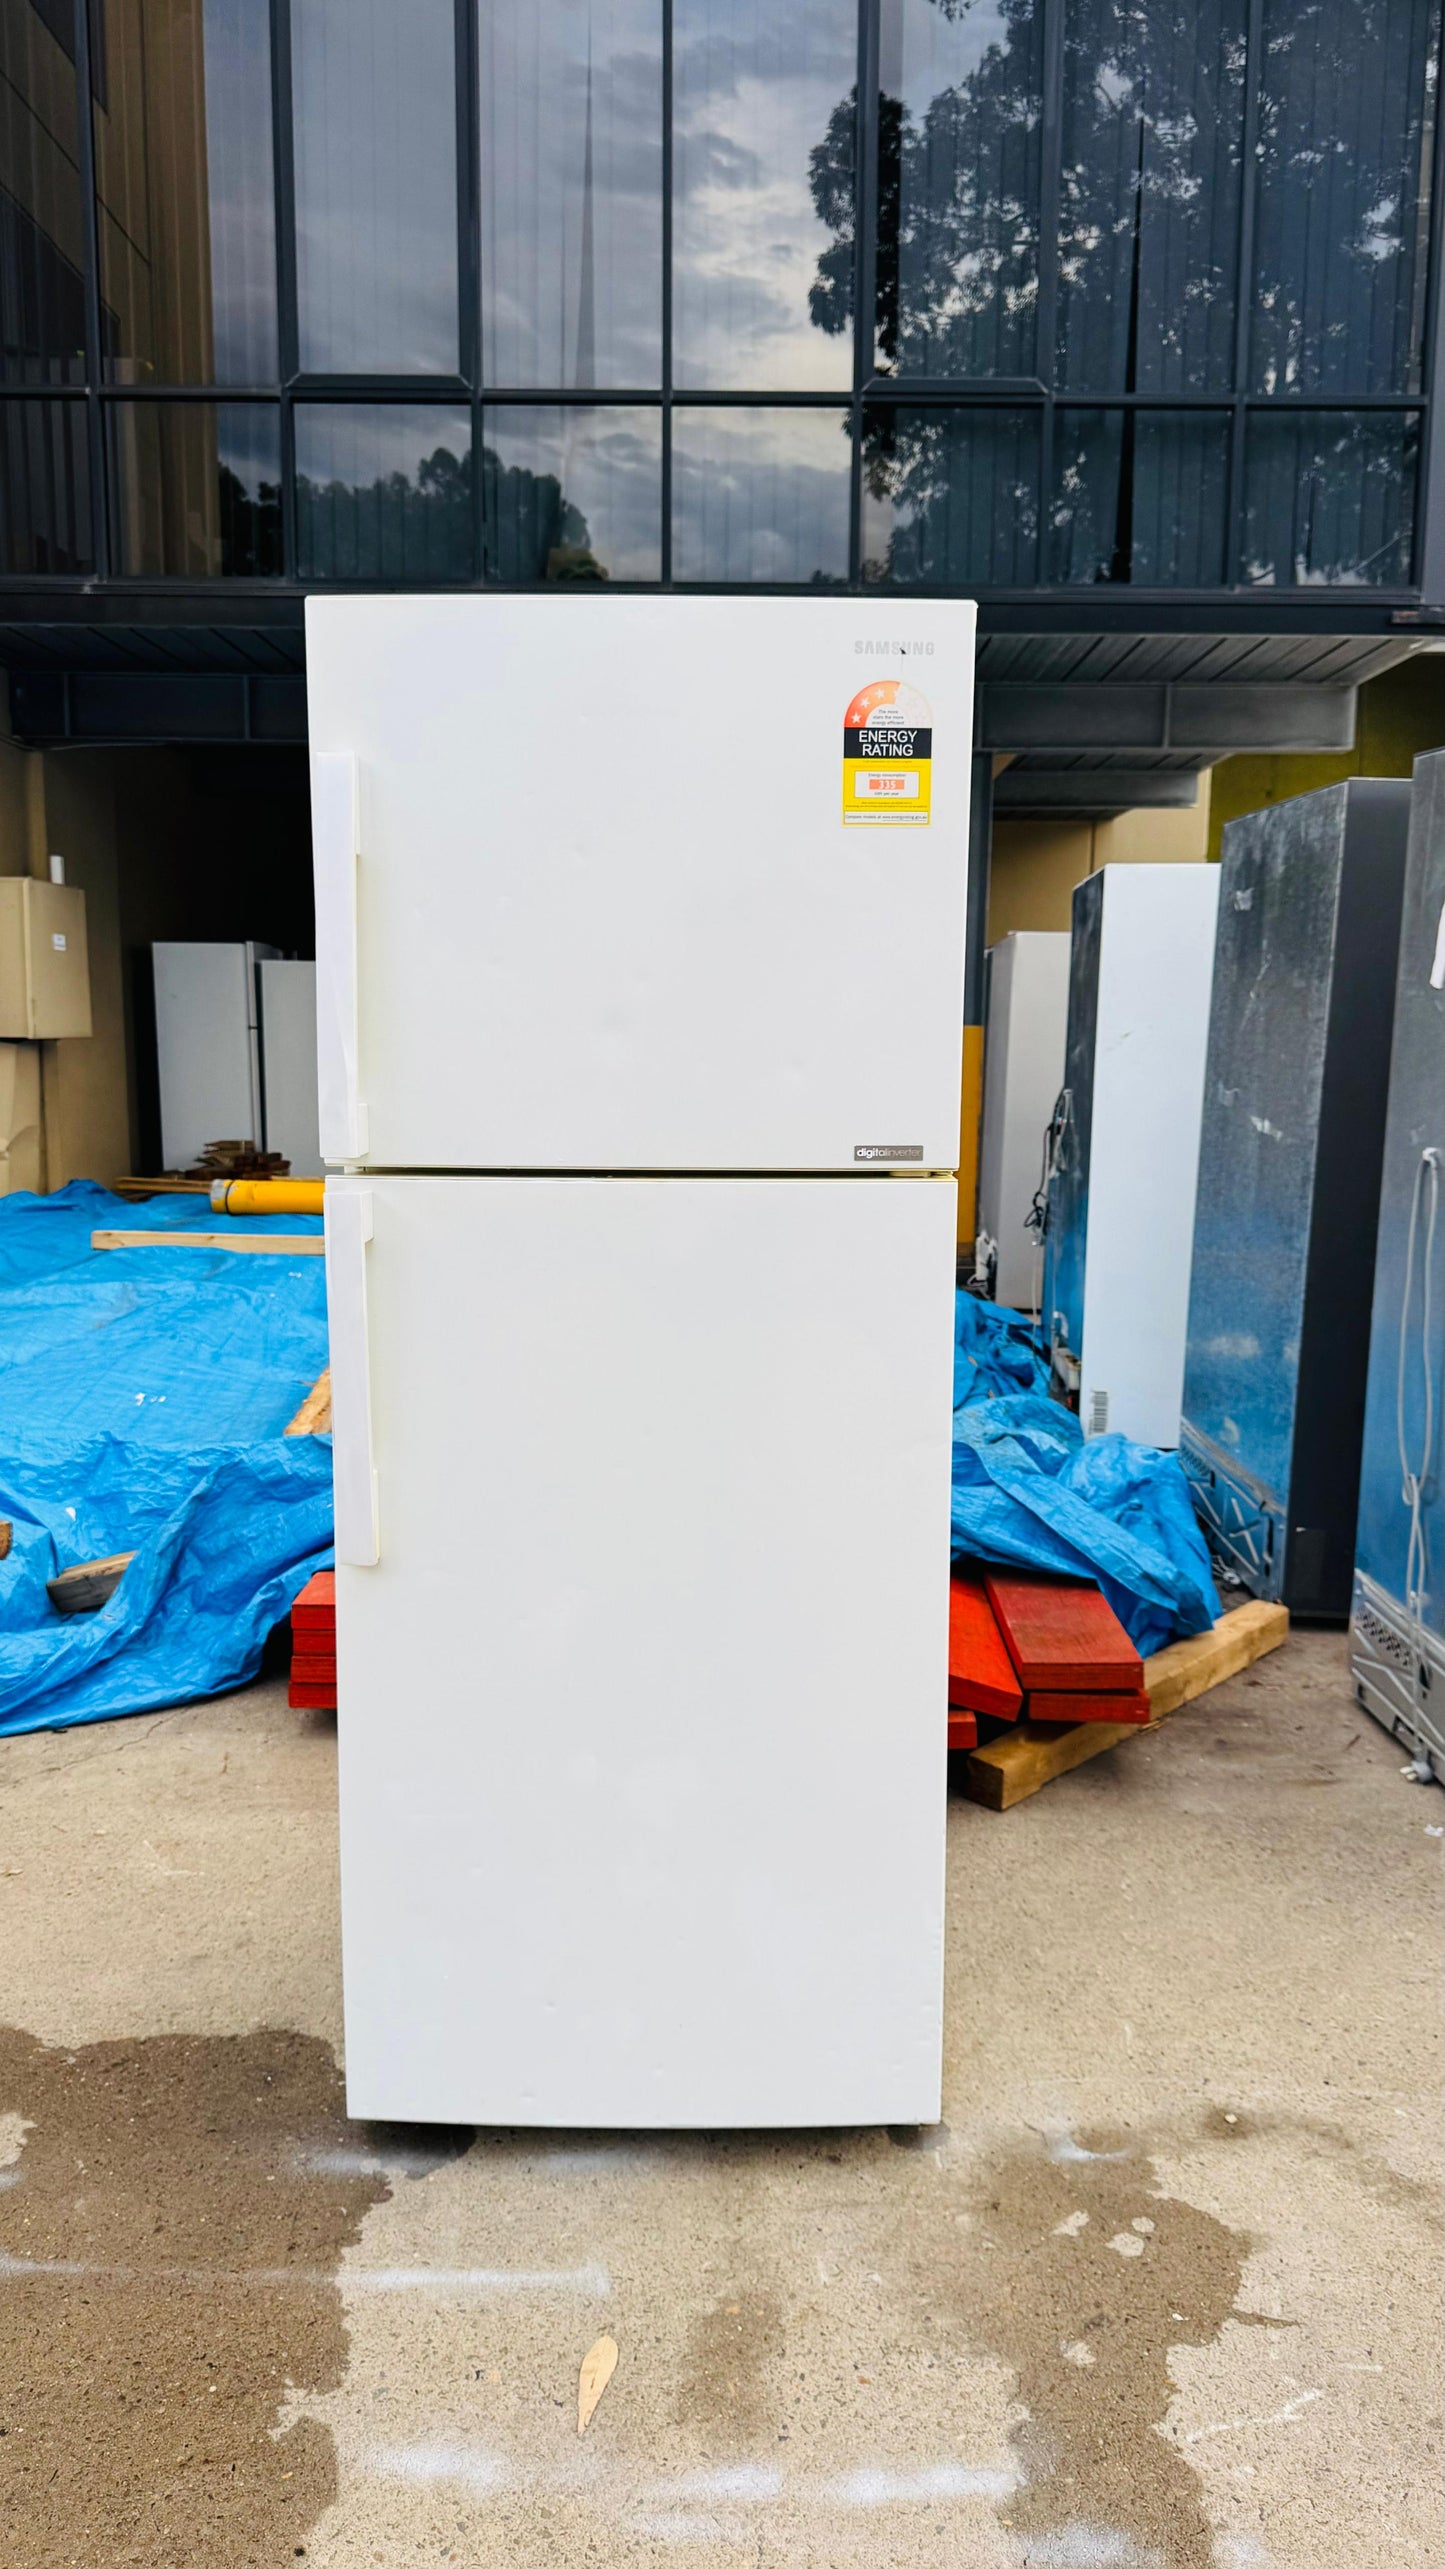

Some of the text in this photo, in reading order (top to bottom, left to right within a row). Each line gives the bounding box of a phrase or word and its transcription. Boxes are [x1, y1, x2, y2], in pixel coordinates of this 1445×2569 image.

[854, 640, 935, 655] SAMSUNG
[859, 730, 918, 743] ENERGY
[862, 744, 914, 756] RATING
[879, 780, 896, 790] 335
